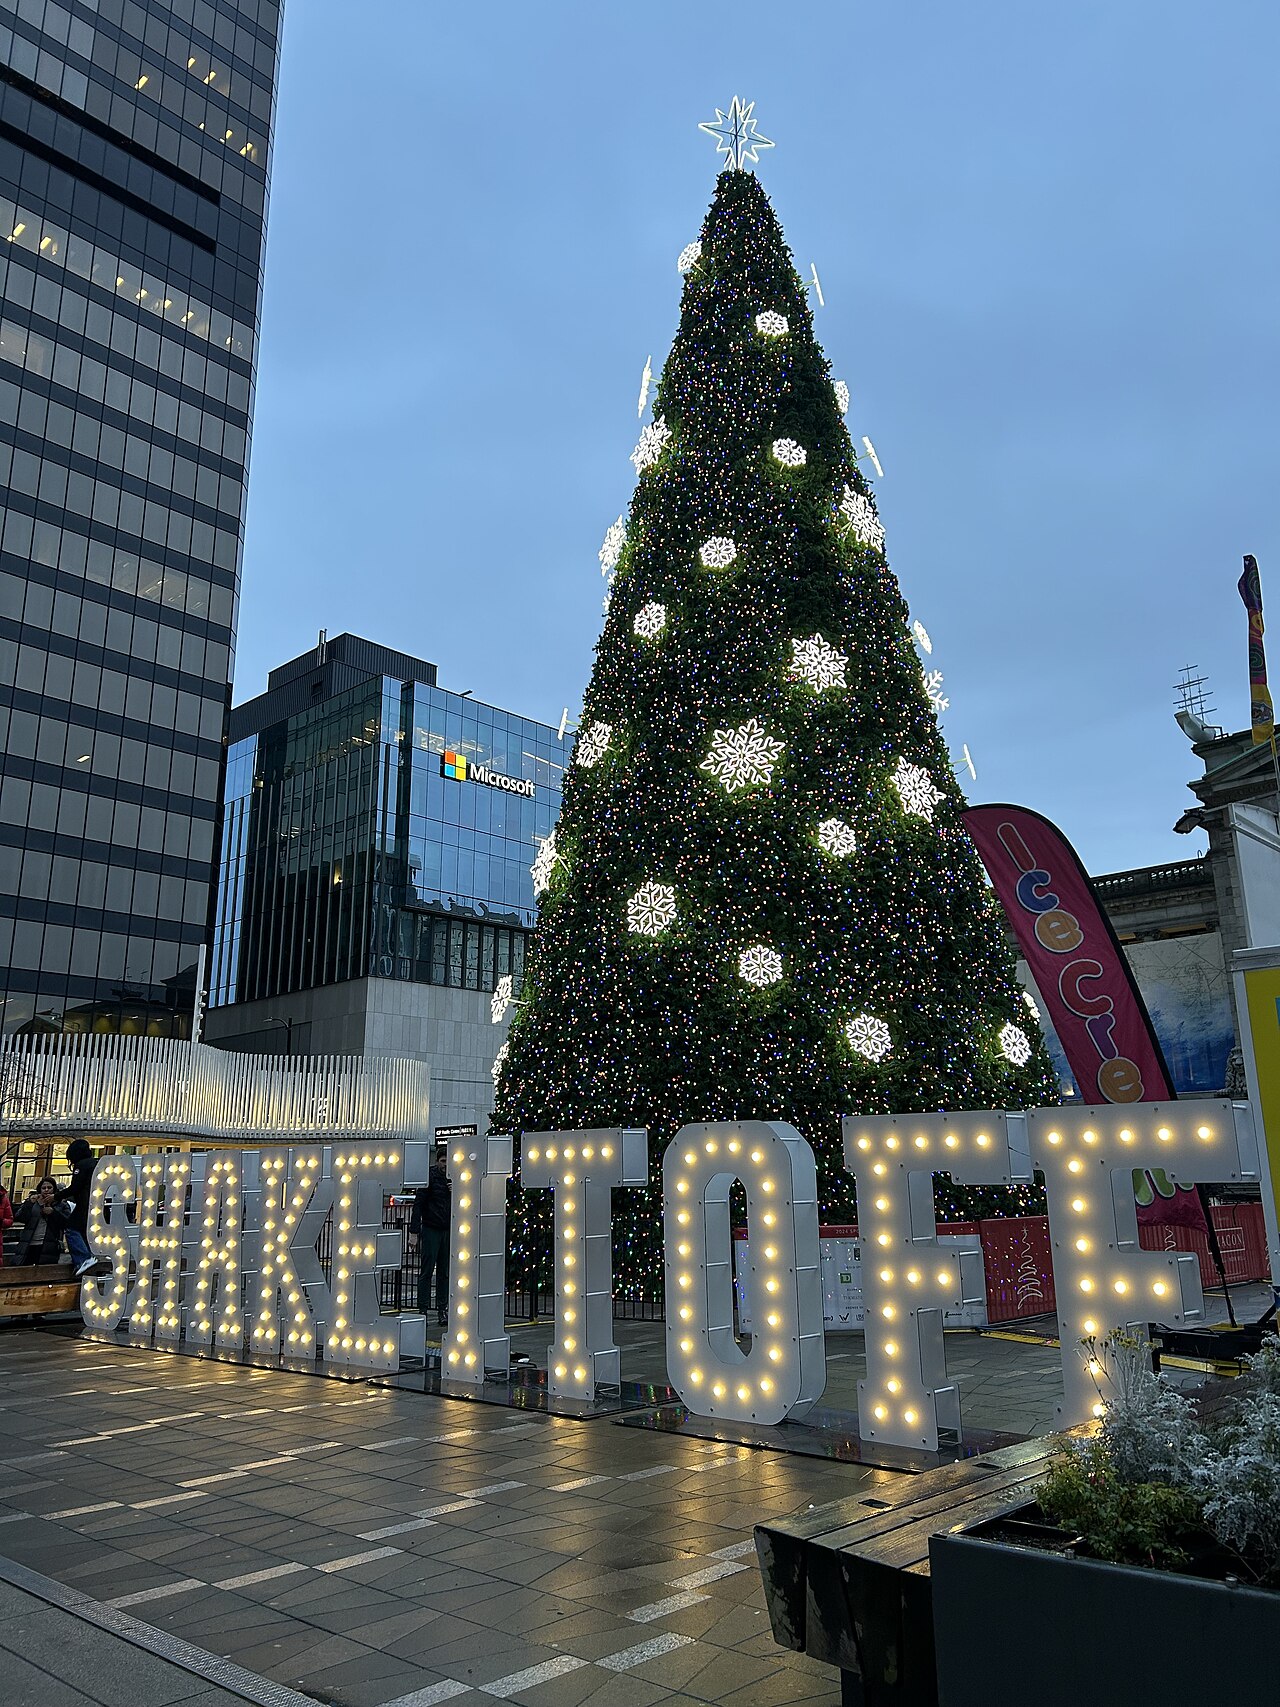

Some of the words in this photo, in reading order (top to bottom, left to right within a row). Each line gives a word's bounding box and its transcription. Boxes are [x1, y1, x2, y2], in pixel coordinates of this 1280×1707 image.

[470, 763, 536, 797] Microsoft
[997, 822, 1085, 953] Ice
[80, 1139, 428, 1372] SHAKE
[441, 1127, 649, 1401] IT
[663, 1099, 1260, 1452] OFF
